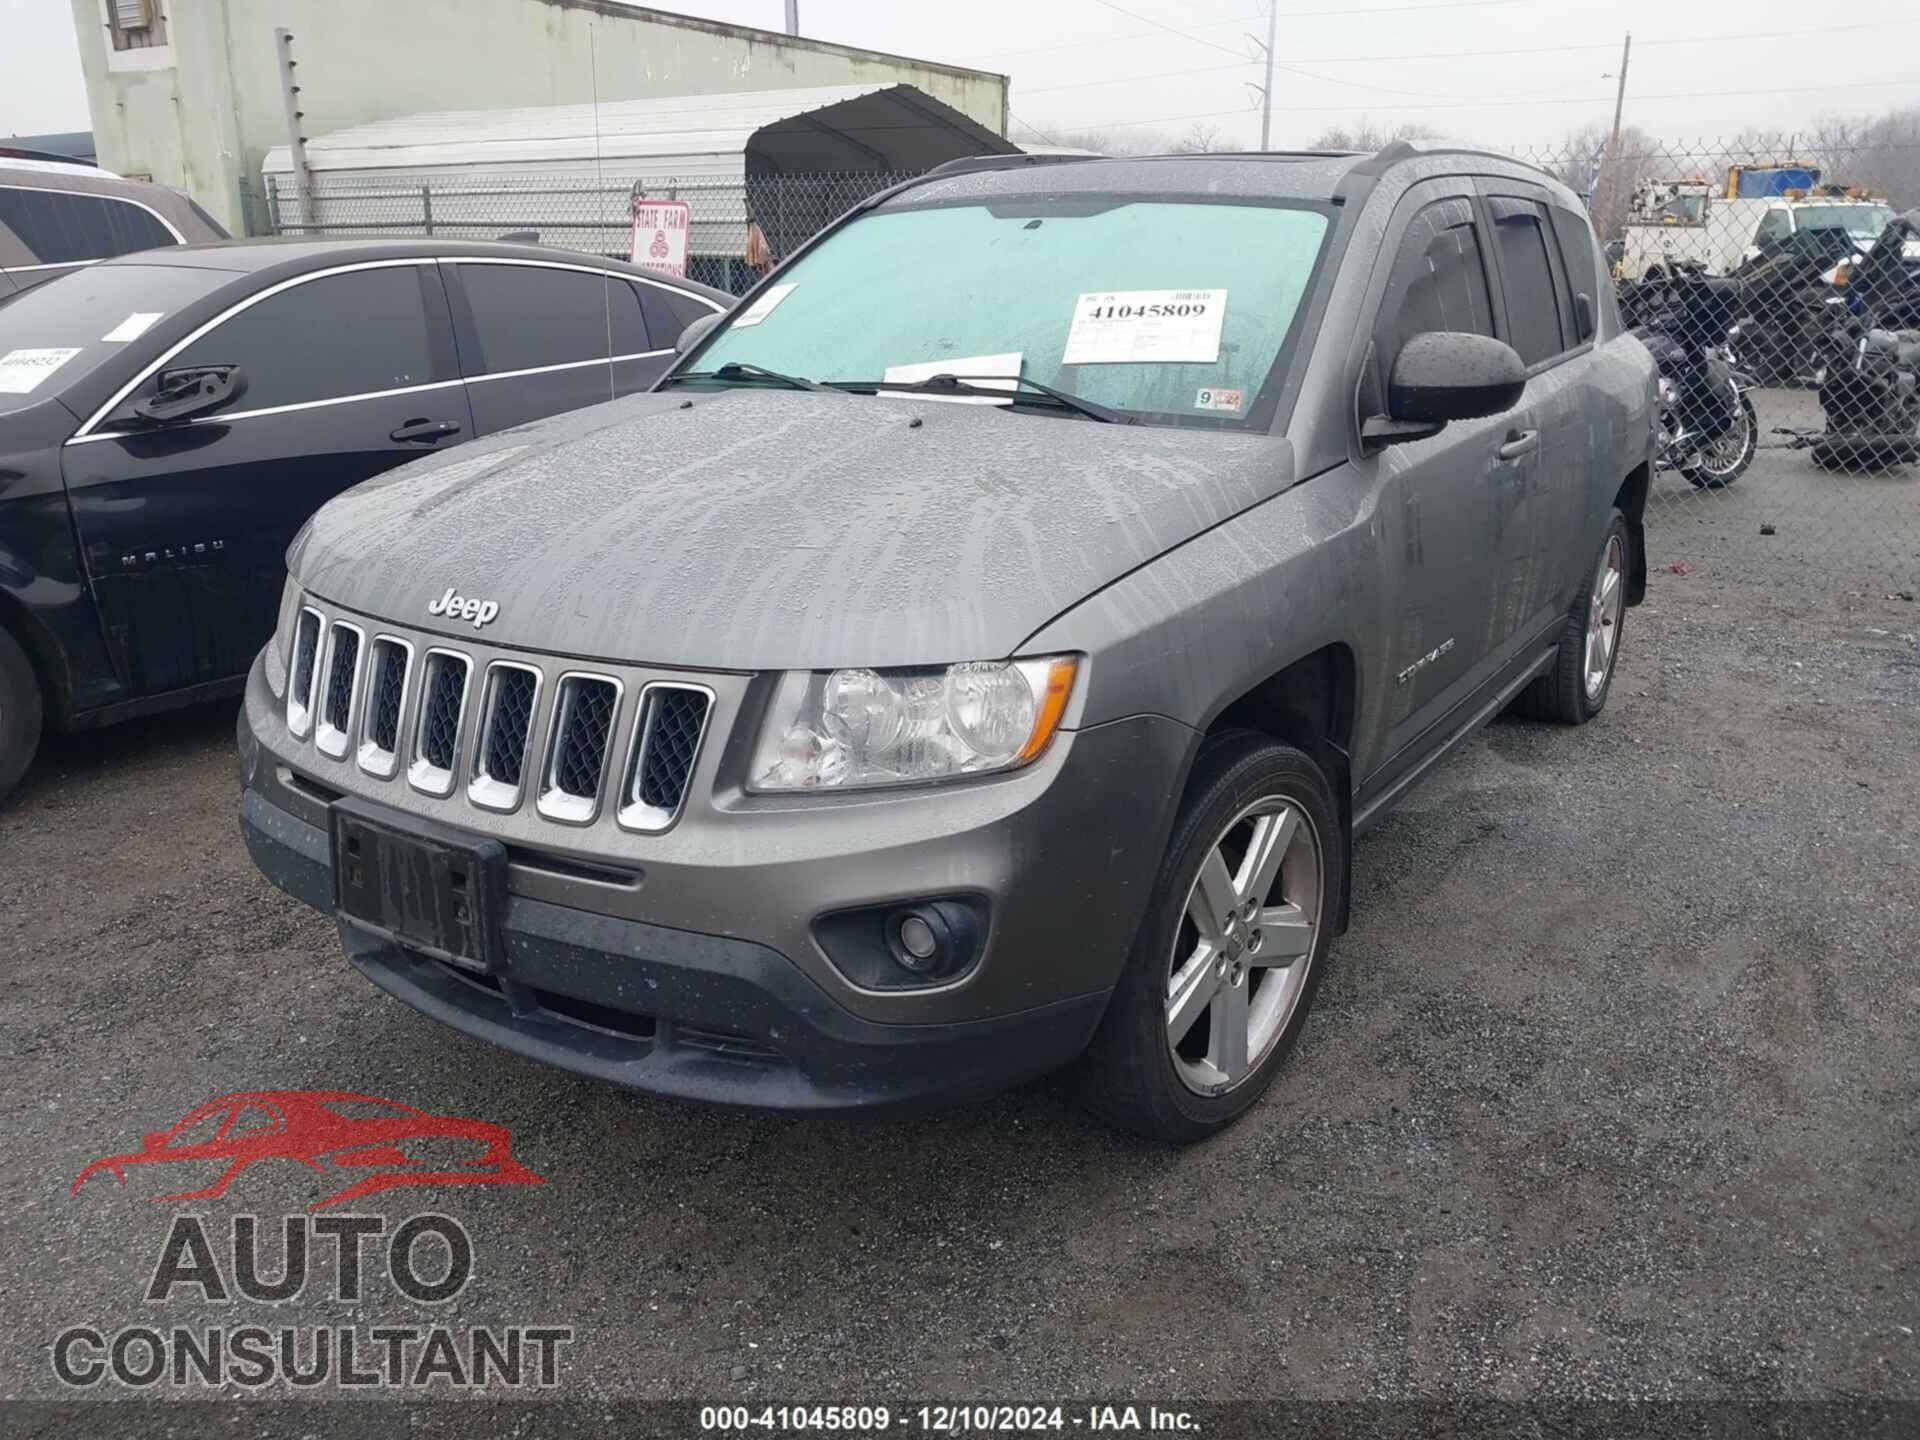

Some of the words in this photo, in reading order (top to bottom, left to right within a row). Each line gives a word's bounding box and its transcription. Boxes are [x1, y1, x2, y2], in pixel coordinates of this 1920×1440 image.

[635, 207, 657, 229] STATE
[665, 208, 686, 230] FARM
[1089, 304, 1206, 319] 41045809
[1200, 391, 1211, 404] 9
[428, 587, 499, 629] Jeep
